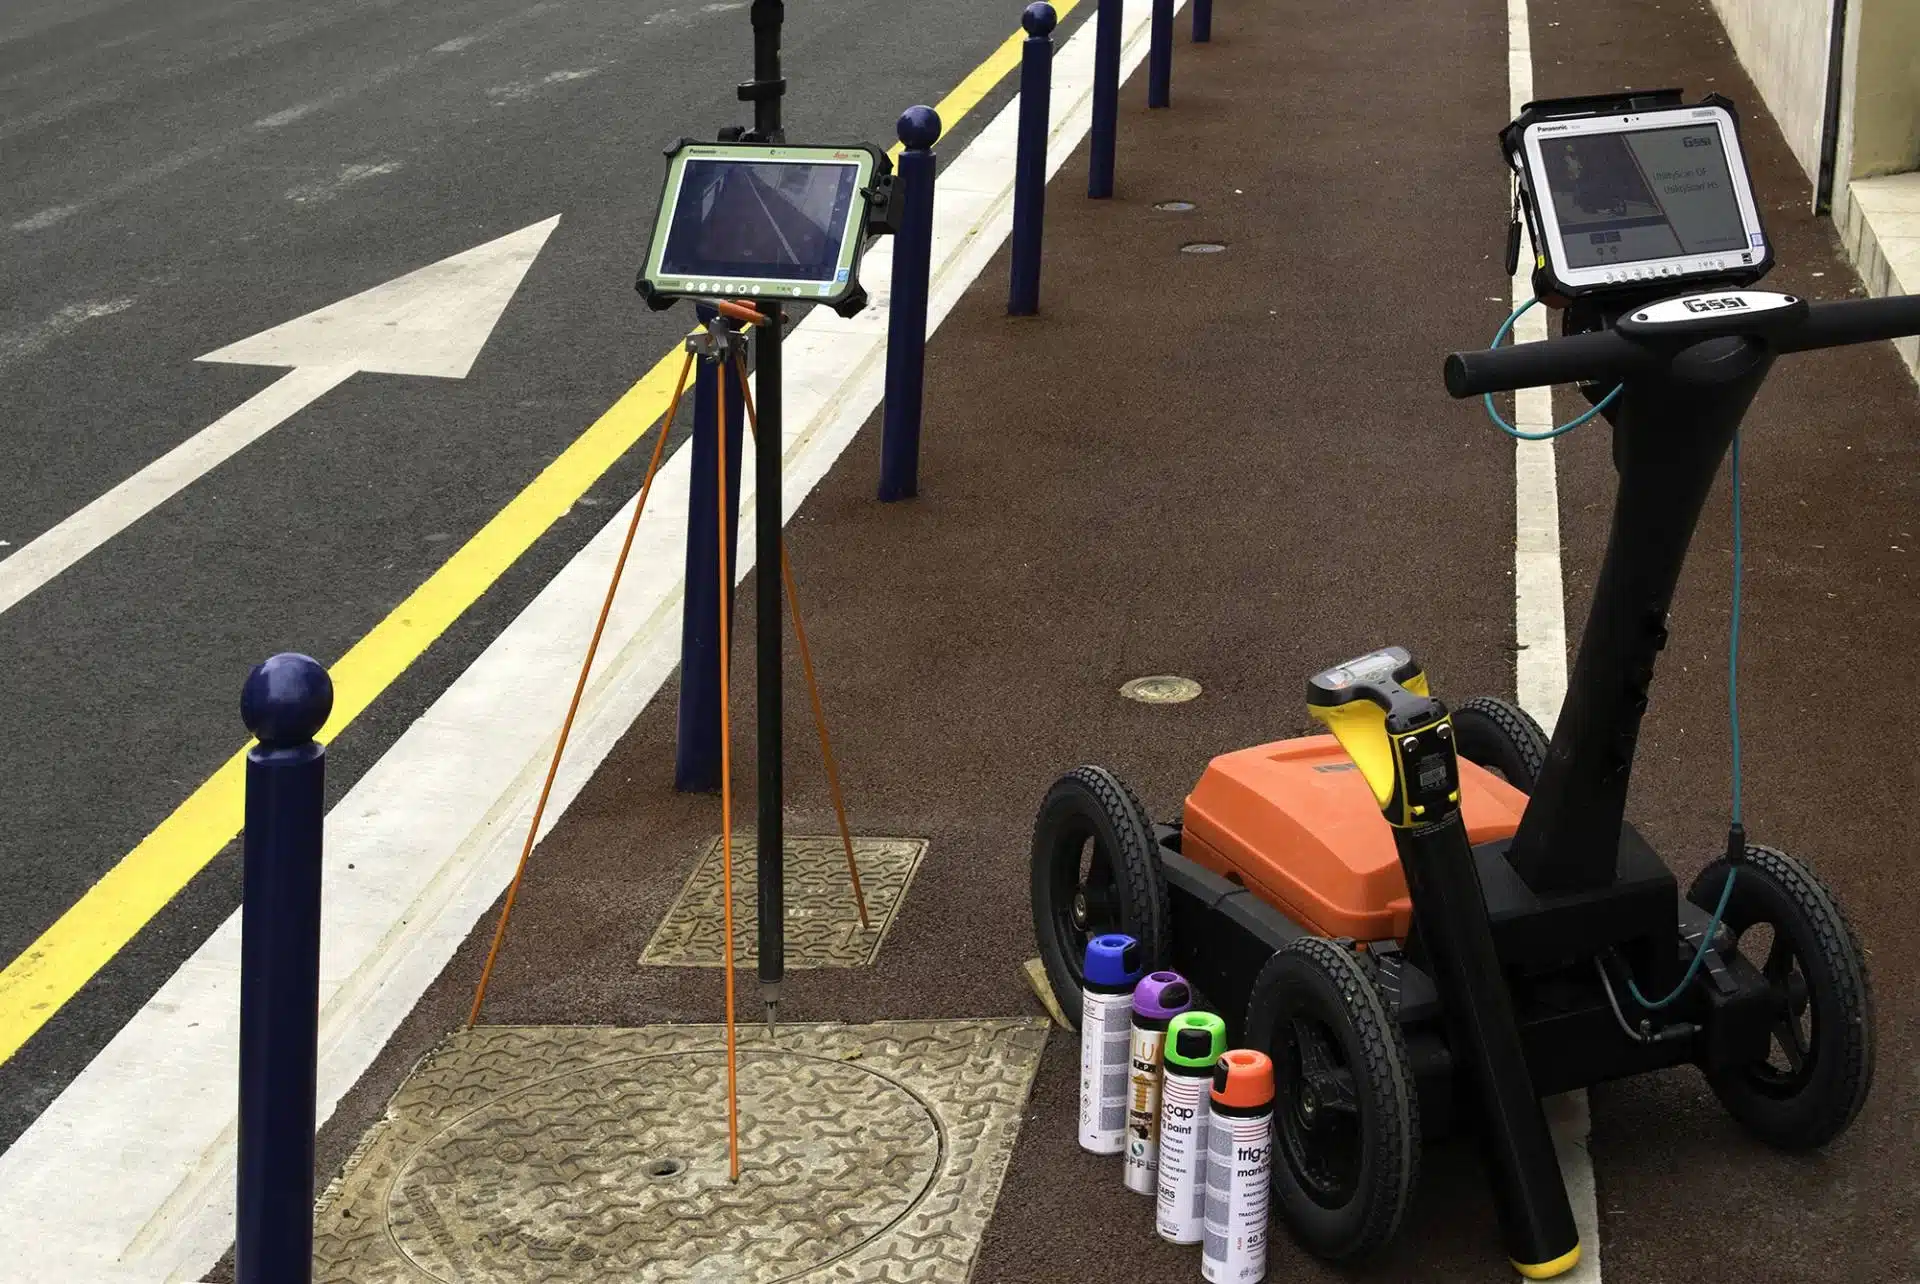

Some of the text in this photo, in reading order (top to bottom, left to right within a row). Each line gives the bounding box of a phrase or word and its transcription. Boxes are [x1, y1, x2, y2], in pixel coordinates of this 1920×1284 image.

[1682, 296, 1748, 313] GSSI
[1167, 1123, 1192, 1135] paint
[1247, 1235, 1258, 1243] 40
